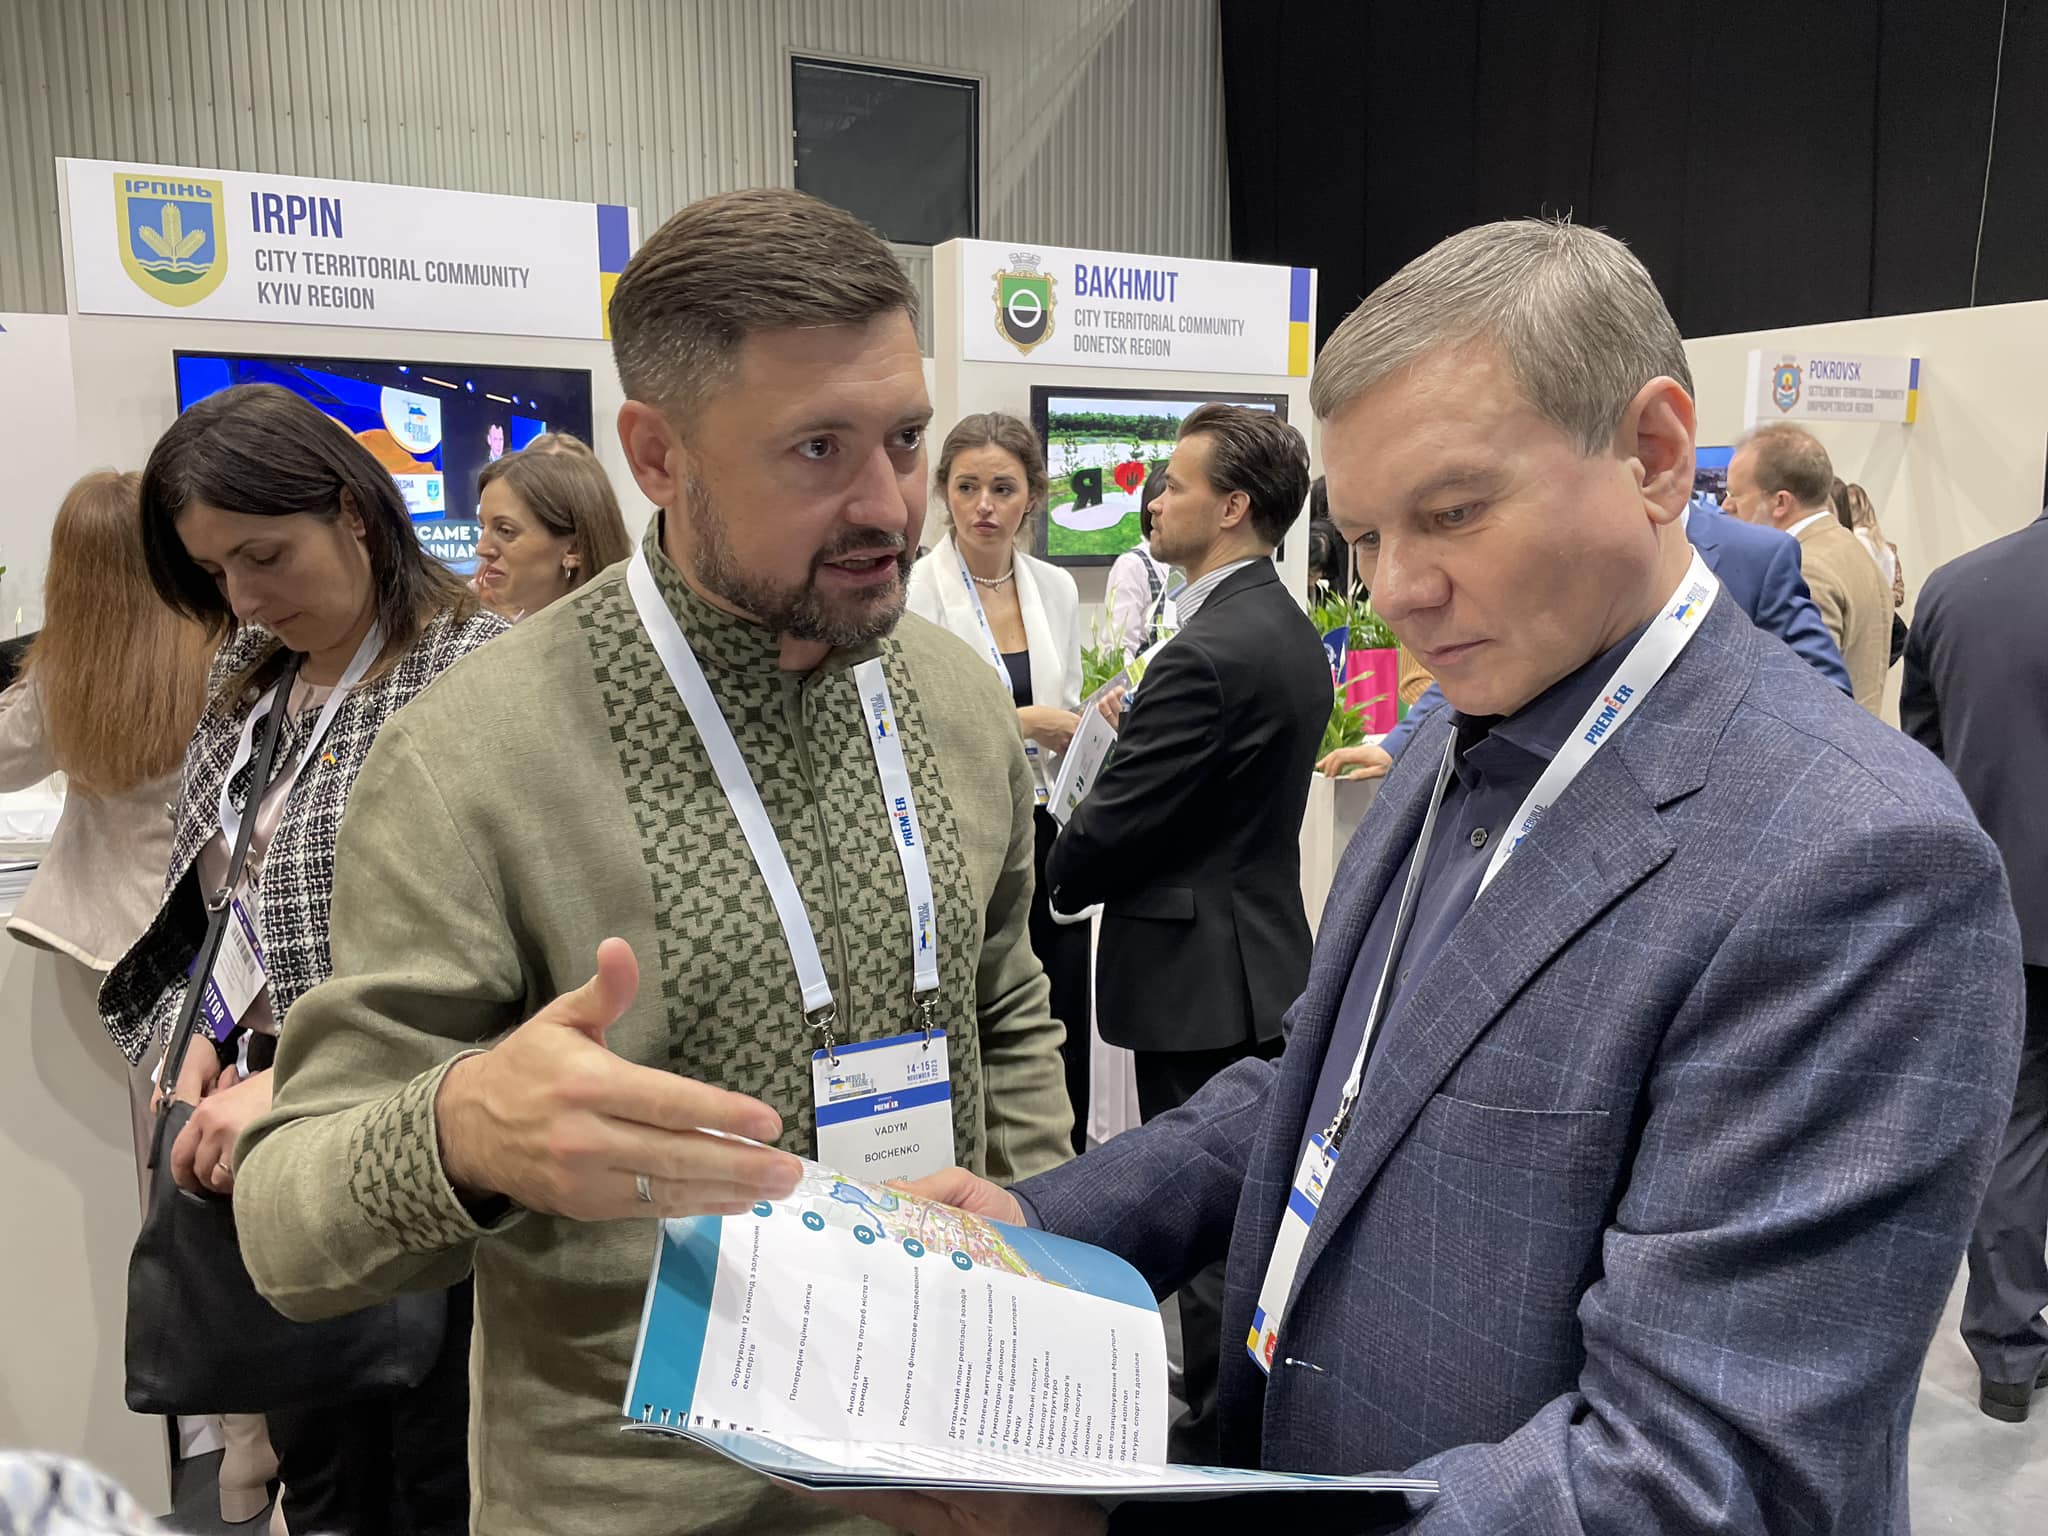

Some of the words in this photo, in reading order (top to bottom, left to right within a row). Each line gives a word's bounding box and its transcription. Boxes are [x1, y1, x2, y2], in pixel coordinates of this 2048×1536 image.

[125, 179, 212, 199] ІРПІНЬ
[250, 191, 343, 239] IRPIN
[255, 248, 297, 273] CITY
[302, 252, 420, 282] TERRITORIAL
[425, 260, 530, 289] COMMUNITY
[1075, 263, 1178, 303] BAKHMUT
[257, 281, 301, 307] KYIV
[308, 284, 375, 310] REGION
[1074, 308, 1101, 328] CITY
[1103, 310, 1176, 333] TERRITORIAL
[1179, 315, 1245, 337] COMMUNITY
[1073, 334, 1127, 355] DONETSK
[1130, 337, 1171, 358] REGION
[1809, 359, 1861, 380] POKROVSK
[412, 525, 471, 541] CAME
[1584, 684, 1634, 745] PREMIER
[893, 797, 914, 847] PREMIER
[205, 982, 225, 1025] SITOR
[874, 1121, 908, 1137] VADYM
[864, 1143, 920, 1163] BOICHENKO
[808, 1214, 818, 1226] 2
[860, 1230, 870, 1240] 3
[909, 1244, 919, 1253] 4
[958, 1255, 968, 1266] 5
[745, 1280, 756, 1314] команд
[742, 1315, 750, 1325] 12
[731, 1327, 748, 1387] Формування
[789, 1349, 805, 1401] Попередня
[799, 1317, 809, 1348] оцінка
[846, 1382, 858, 1415] Аналіз
[858, 1308, 867, 1341] потреб
[857, 1376, 869, 1417] громади
[899, 1383, 912, 1428] Ресурсне
[949, 1388, 961, 1439] Детальний
[960, 1416, 967, 1427] 12
[978, 1398, 988, 1437] Безпека
[1083, 1415, 1092, 1458] кономіка
